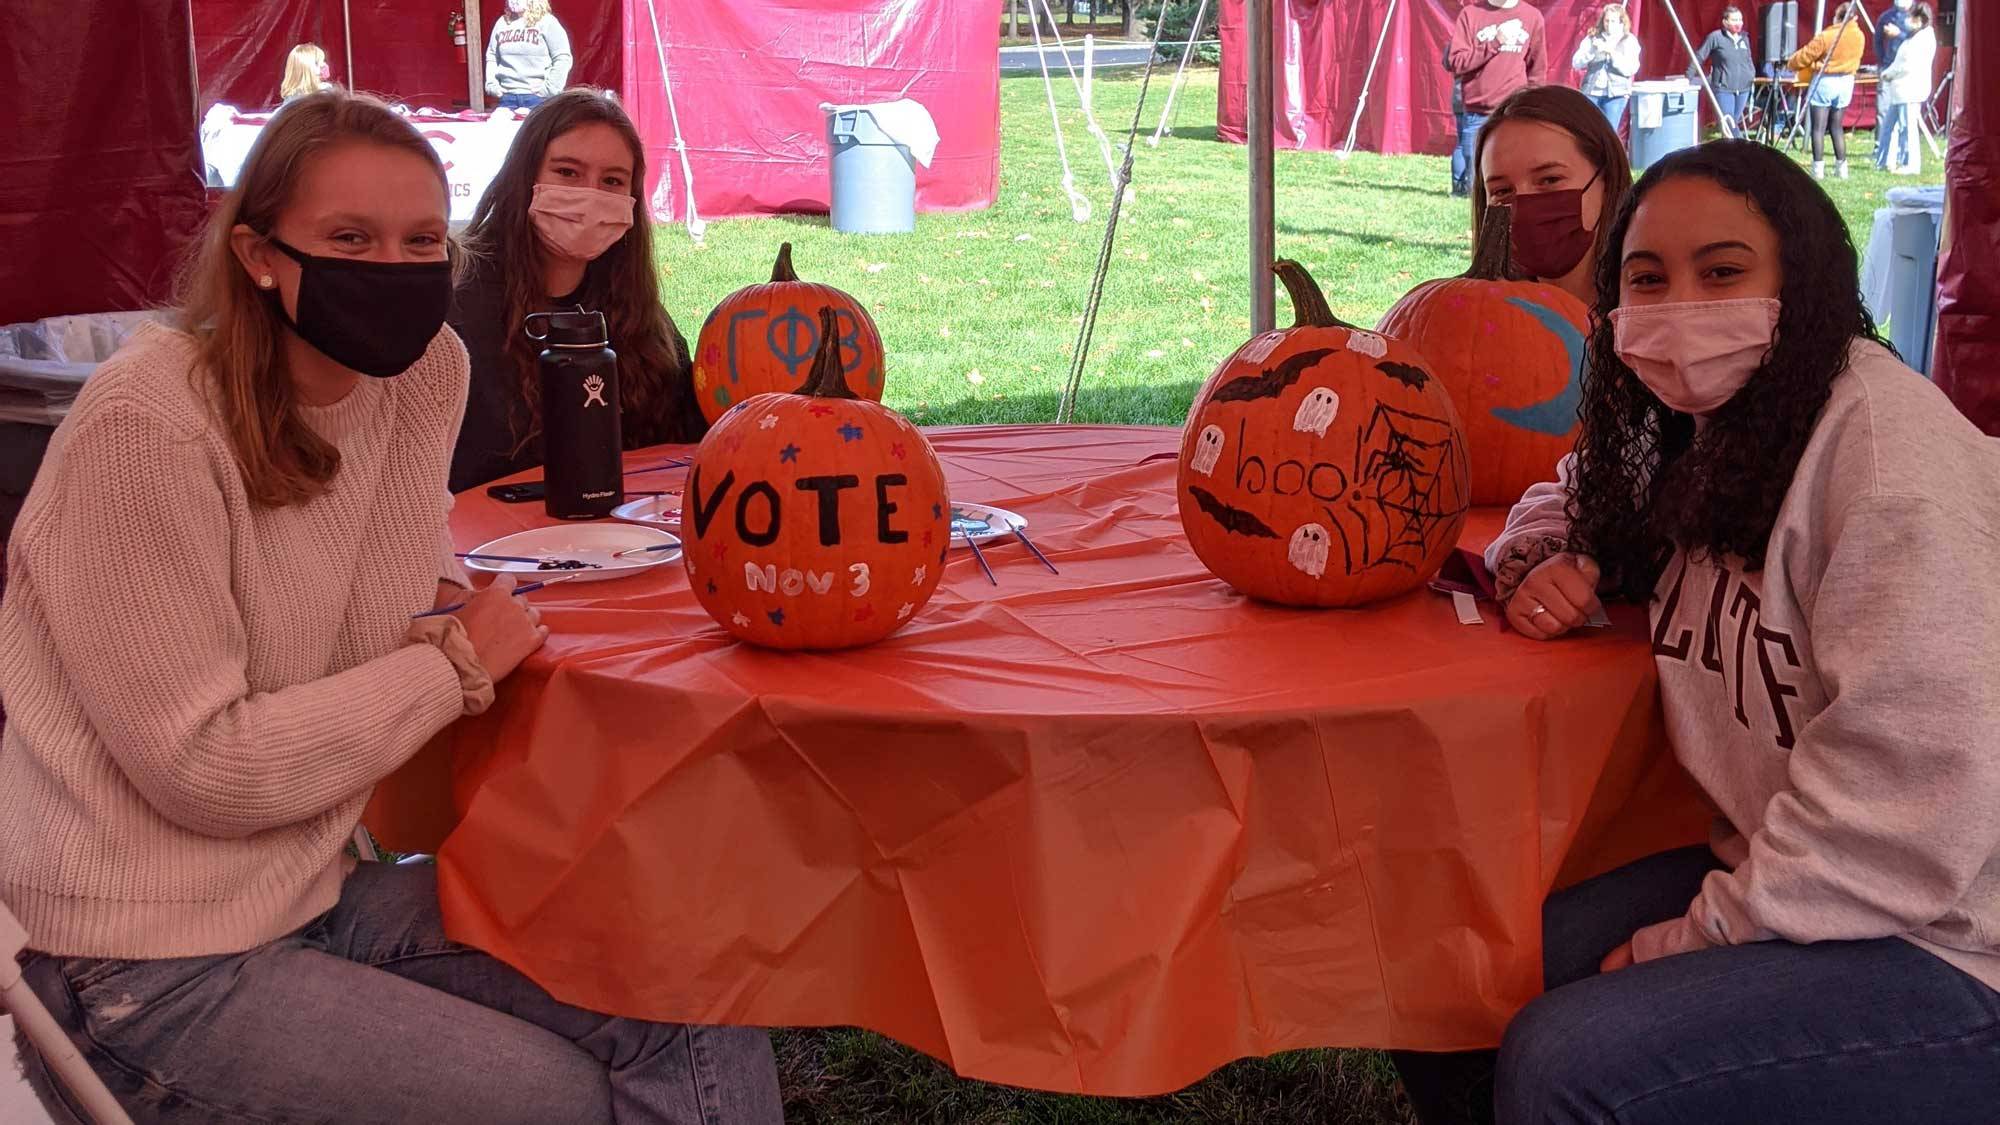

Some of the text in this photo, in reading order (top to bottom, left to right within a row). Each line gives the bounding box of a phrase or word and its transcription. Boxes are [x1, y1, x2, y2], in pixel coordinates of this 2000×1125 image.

[1235, 417, 1364, 502] boo!
[692, 463, 909, 547] VOTE
[849, 562, 871, 597] 3
